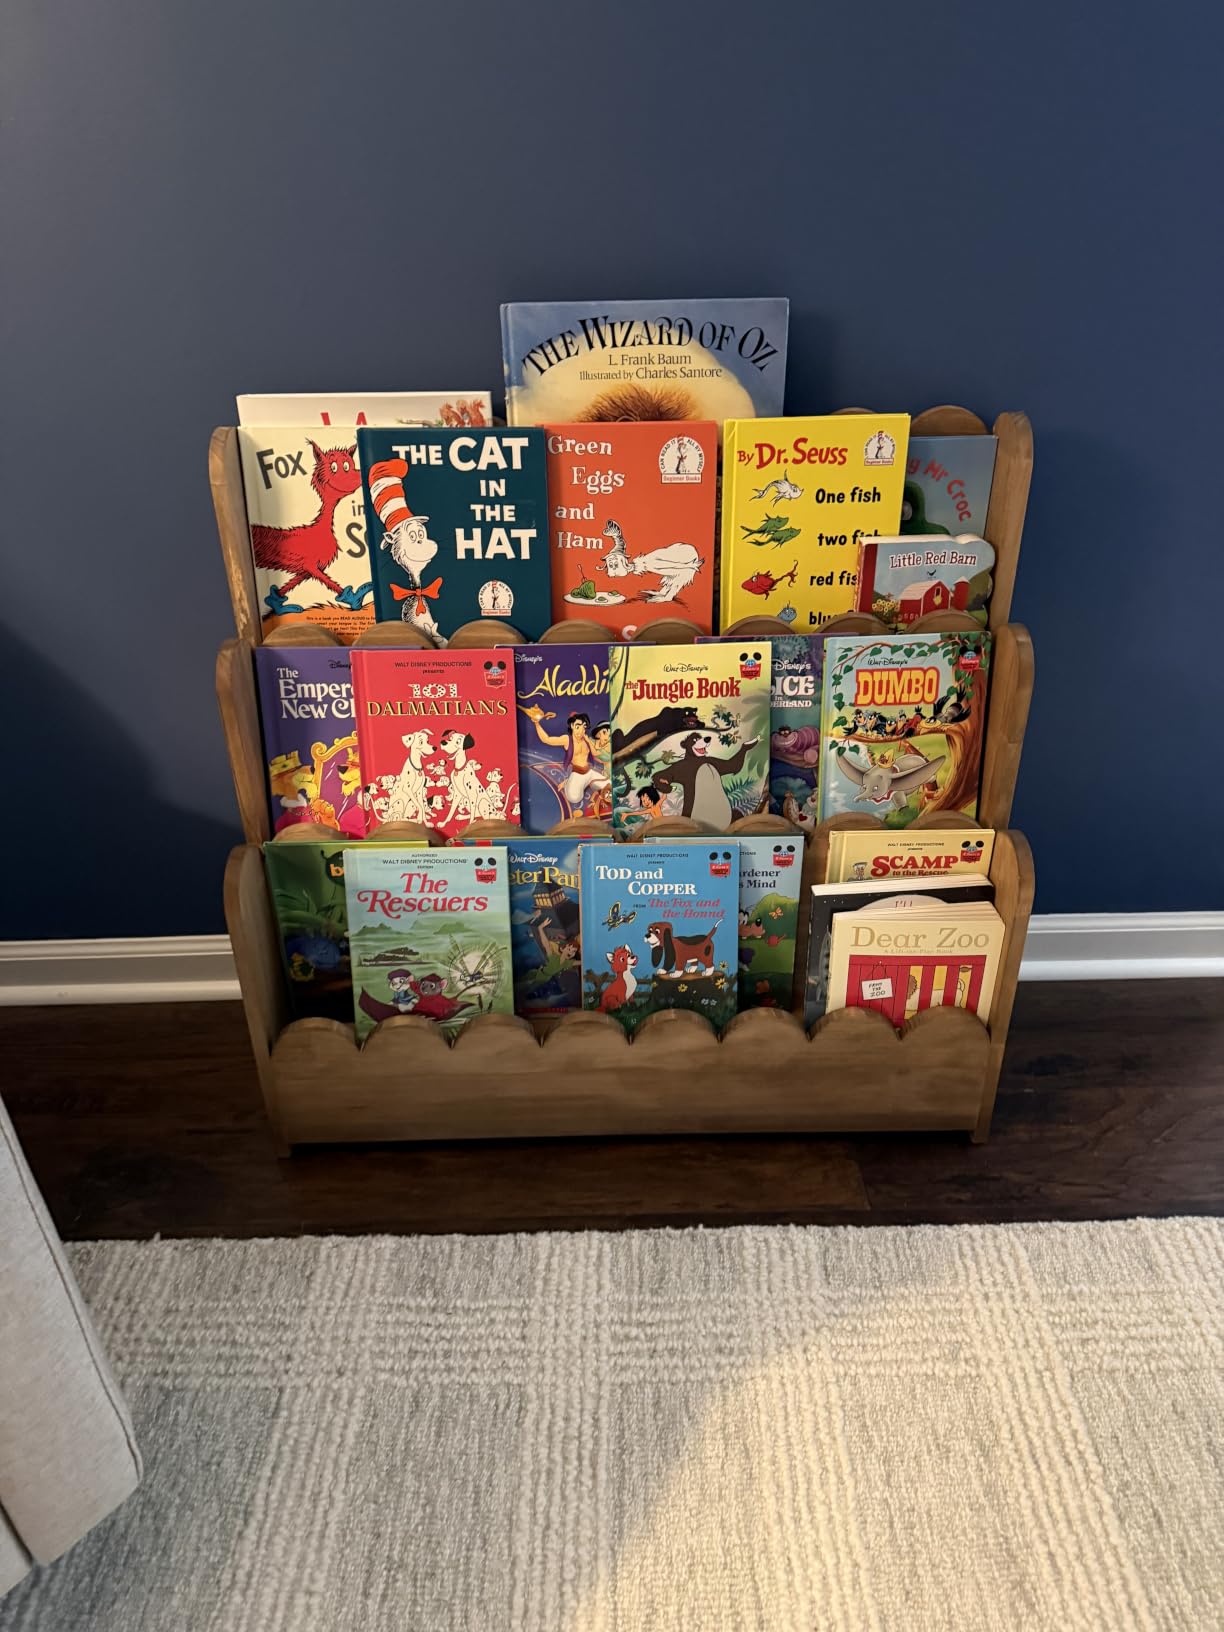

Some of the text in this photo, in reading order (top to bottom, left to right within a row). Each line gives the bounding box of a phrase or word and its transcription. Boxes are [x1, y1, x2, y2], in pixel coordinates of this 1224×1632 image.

[522, 315, 779, 376] THE WIZARD OF OZ
[621, 353, 655, 366] Frank
[658, 353, 692, 365] Baum
[579, 366, 722, 382] Illustrated by Charles Santore
[392, 436, 529, 471] THE CAT
[547, 435, 613, 456] Green
[737, 450, 754, 466] By
[755, 443, 789, 470] Dr.
[792, 437, 848, 466] Seuss
[256, 448, 307, 490] Fox
[480, 479, 506, 497] IN
[571, 466, 625, 495] Eggs
[815, 486, 881, 504] One fish
[923, 457, 949, 482] Mr
[946, 479, 973, 523] Croc
[470, 504, 516, 522] THE
[555, 503, 595, 520] and
[455, 527, 537, 560] HAT
[557, 531, 604, 549] Ham
[817, 533, 847, 546] two
[889, 551, 977, 569] Little Red Barn
[809, 570, 858, 586] red fis
[276, 667, 299, 679] The
[517, 664, 609, 699] Aladdi
[279, 679, 354, 702] Emper
[407, 683, 462, 699] 101
[632, 678, 694, 703] Jungle
[696, 677, 742, 699] Book
[771, 675, 816, 696] ICE
[856, 667, 939, 705] DUMBO
[281, 699, 329, 719] New
[366, 699, 508, 717] DALMATIANS
[771, 700, 813, 708] ERLAND
[635, 868, 663, 880] and
[739, 868, 781, 878] rdener
[870, 855, 959, 878] SCAMP
[902, 869, 917, 877] the
[918, 869, 949, 877] Rescue
[400, 872, 449, 894] The
[509, 868, 543, 885] eter
[746, 880, 776, 889] Mind
[628, 881, 698, 895] COPPER
[357, 890, 489, 919] Rescuers
[648, 898, 669, 908] The
[671, 898, 692, 908] Fox
[696, 898, 720, 908] and
[662, 909, 725, 918] the Hound
[850, 925, 990, 949] Dear Zoo
